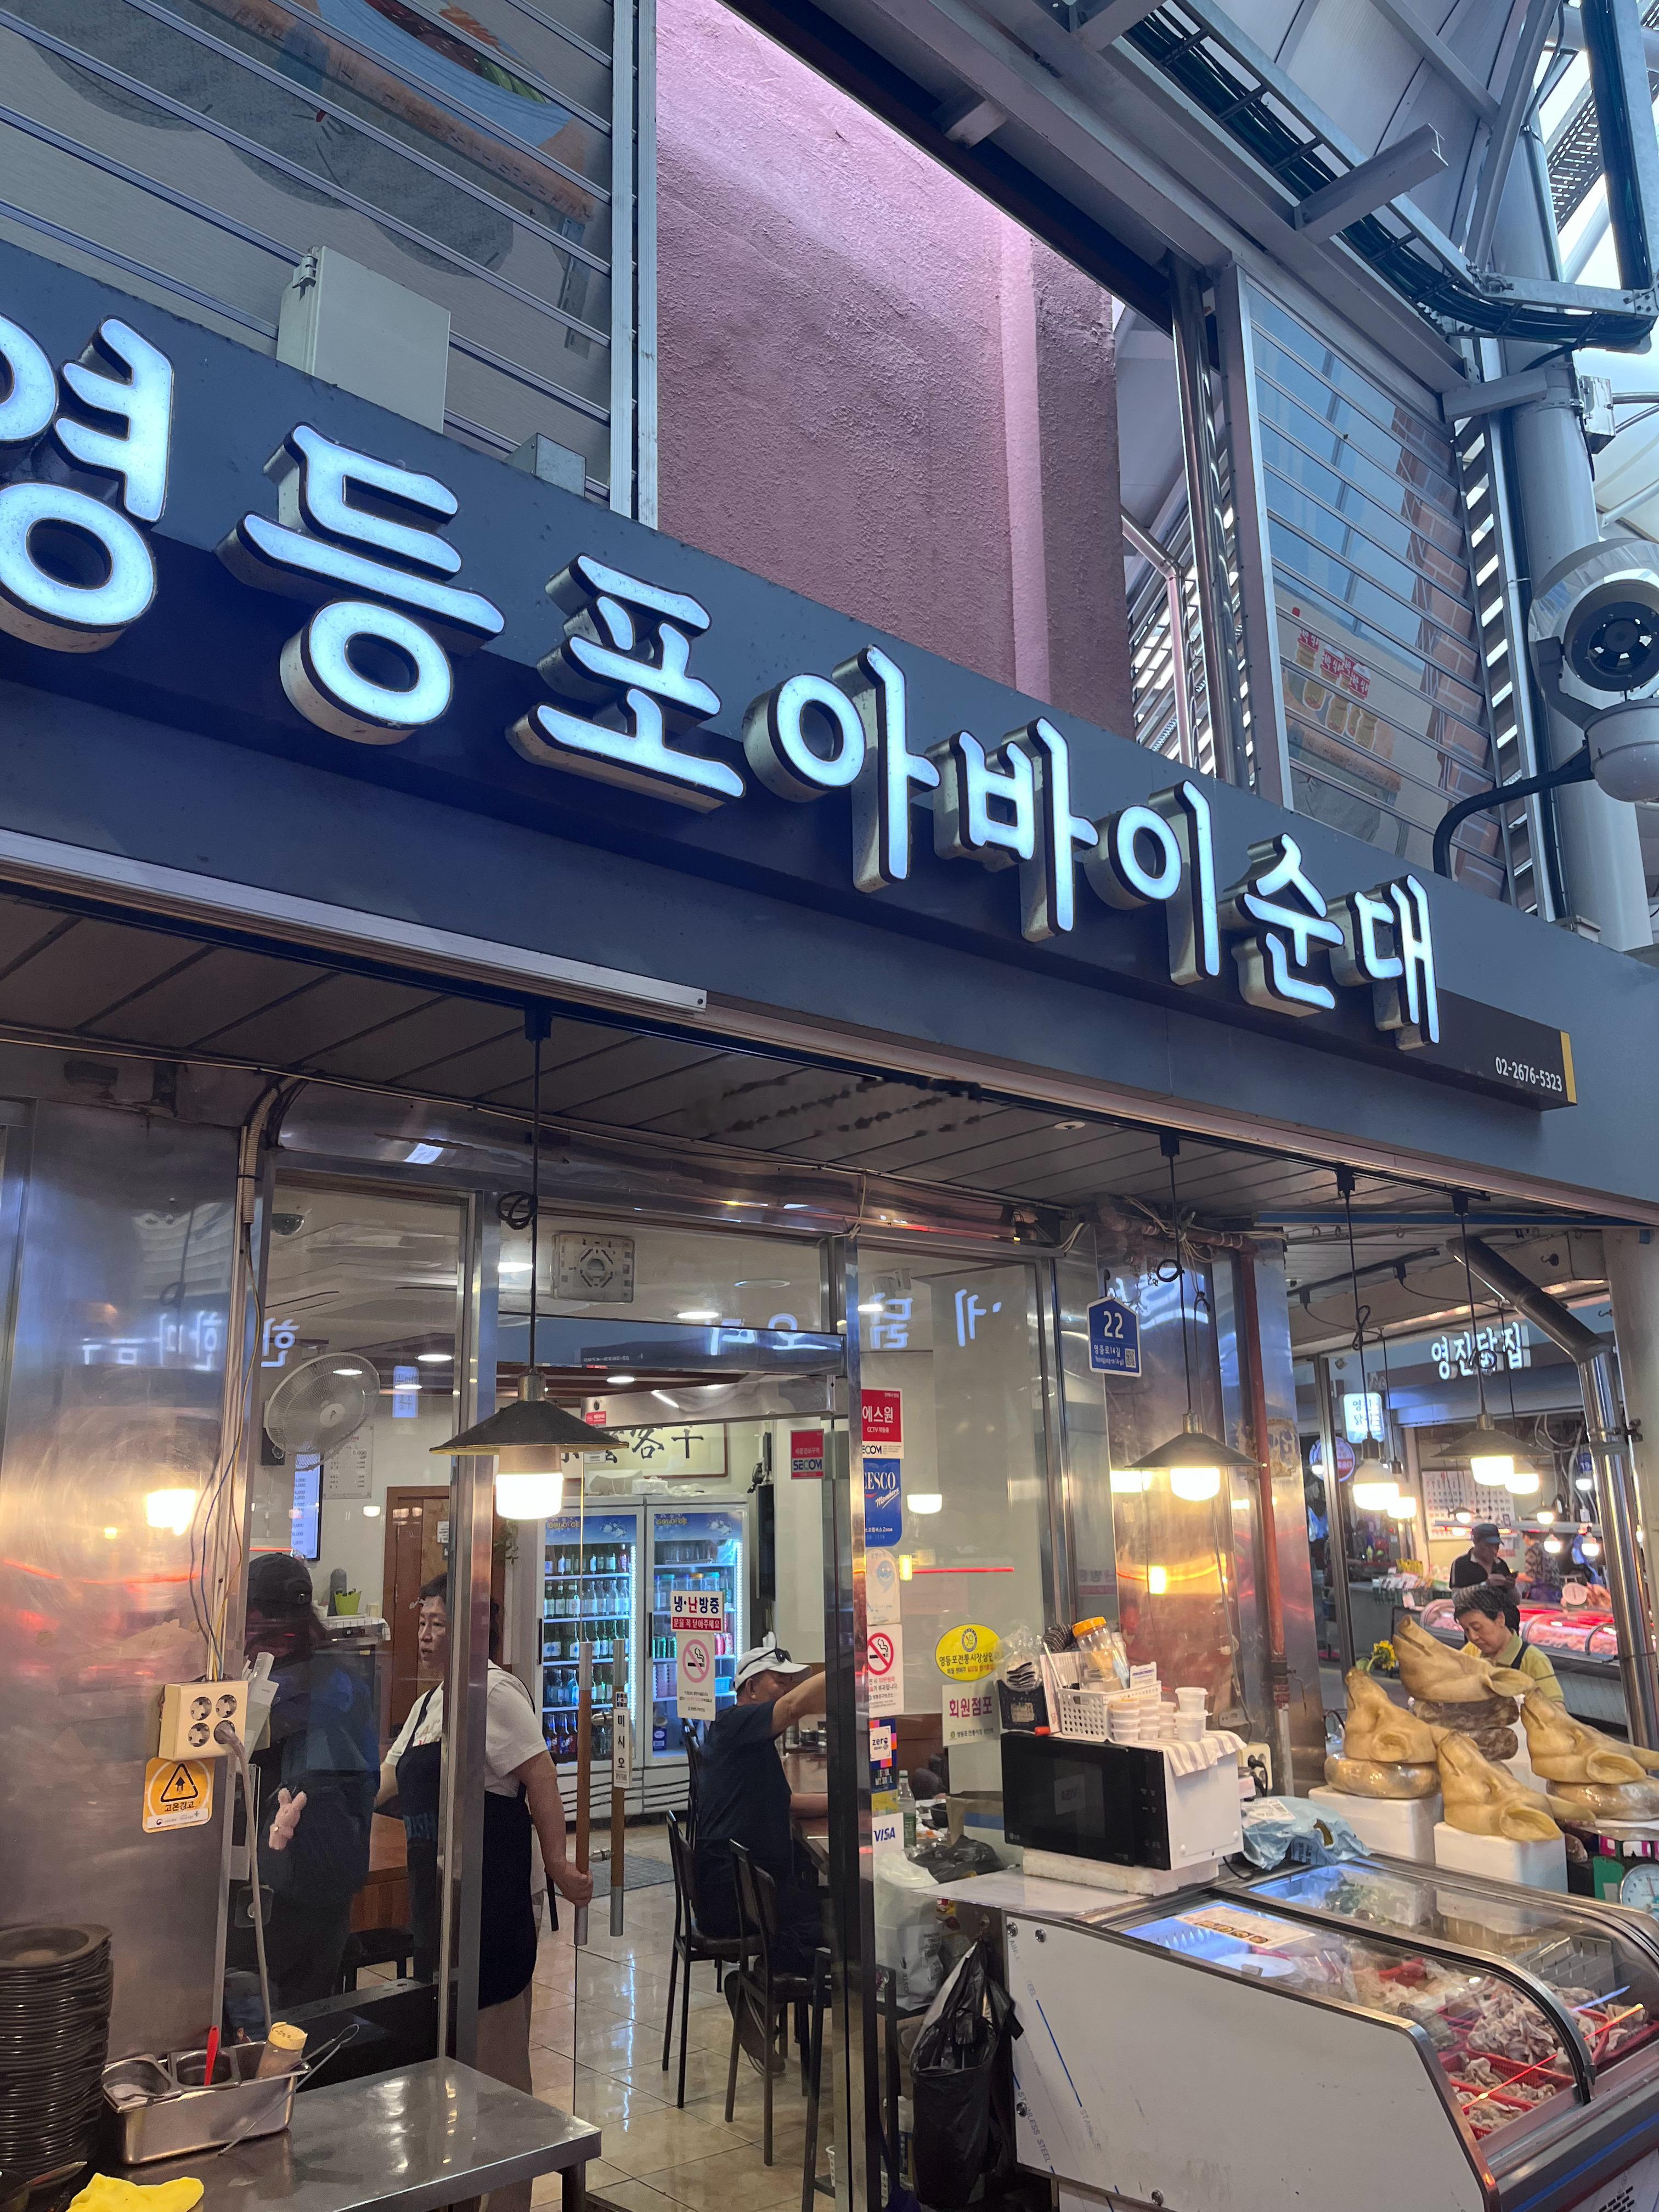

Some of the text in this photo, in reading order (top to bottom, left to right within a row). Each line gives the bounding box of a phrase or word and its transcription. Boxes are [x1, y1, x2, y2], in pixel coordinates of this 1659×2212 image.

[1495, 1056, 1563, 1092] 02-2676-5323
[1103, 1311, 1124, 1339] 22
[862, 1405, 894, 1424] 에스원
[793, 1459, 822, 1471] SECOM
[875, 1487, 900, 1508] Members
[674, 1595, 720, 1615] 냉·난방중
[673, 1618, 720, 1629] 문을 꼭 닫아주세요
[949, 1696, 993, 1719] 회원점포
[873, 1826, 896, 1842] VISA
[1037, 2138, 1052, 2164] STEEL
